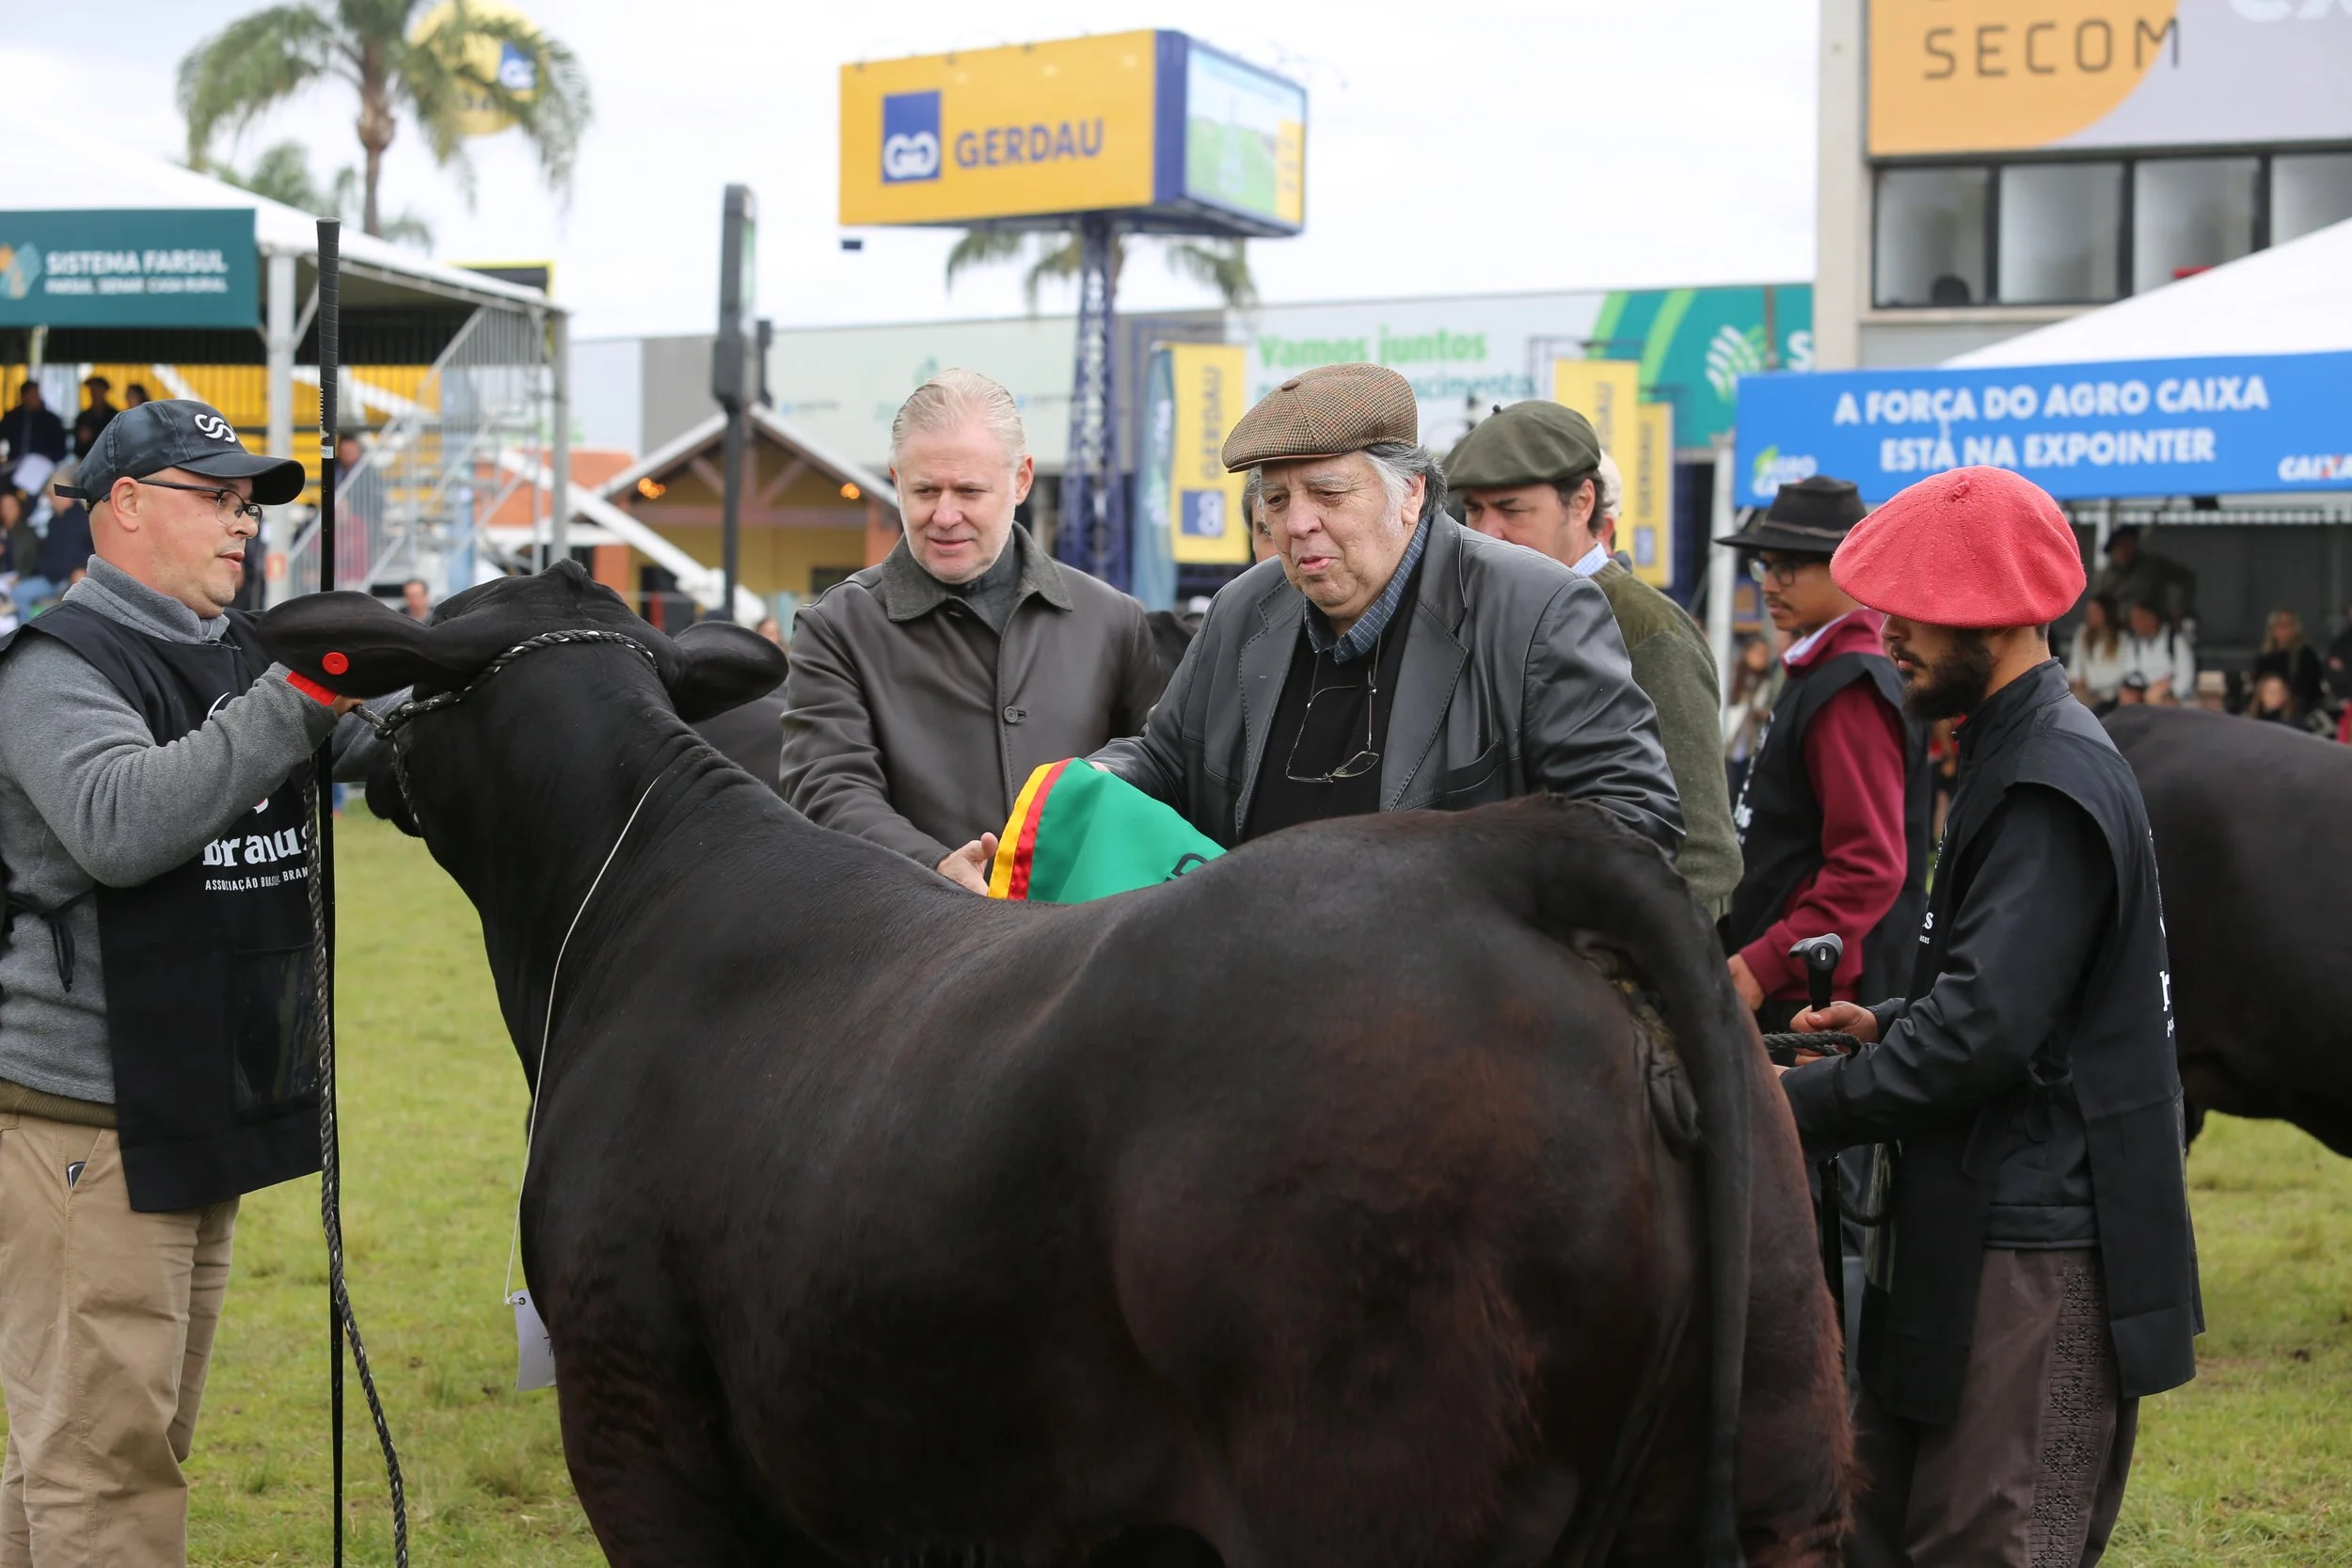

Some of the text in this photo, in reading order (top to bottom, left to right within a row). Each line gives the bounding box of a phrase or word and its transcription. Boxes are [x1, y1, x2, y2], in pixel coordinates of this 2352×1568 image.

[1922, 15, 2181, 80] SECOM
[954, 117, 1104, 169] GERDAU
[46, 249, 229, 276] SISTEMA FARSUL
[1257, 324, 1487, 368] Vamos juntos
[1833, 373, 2271, 431] A FORÇA DO AGRO CAIXA
[1880, 425, 2217, 472] ESTÁ NA EXPOINTER
